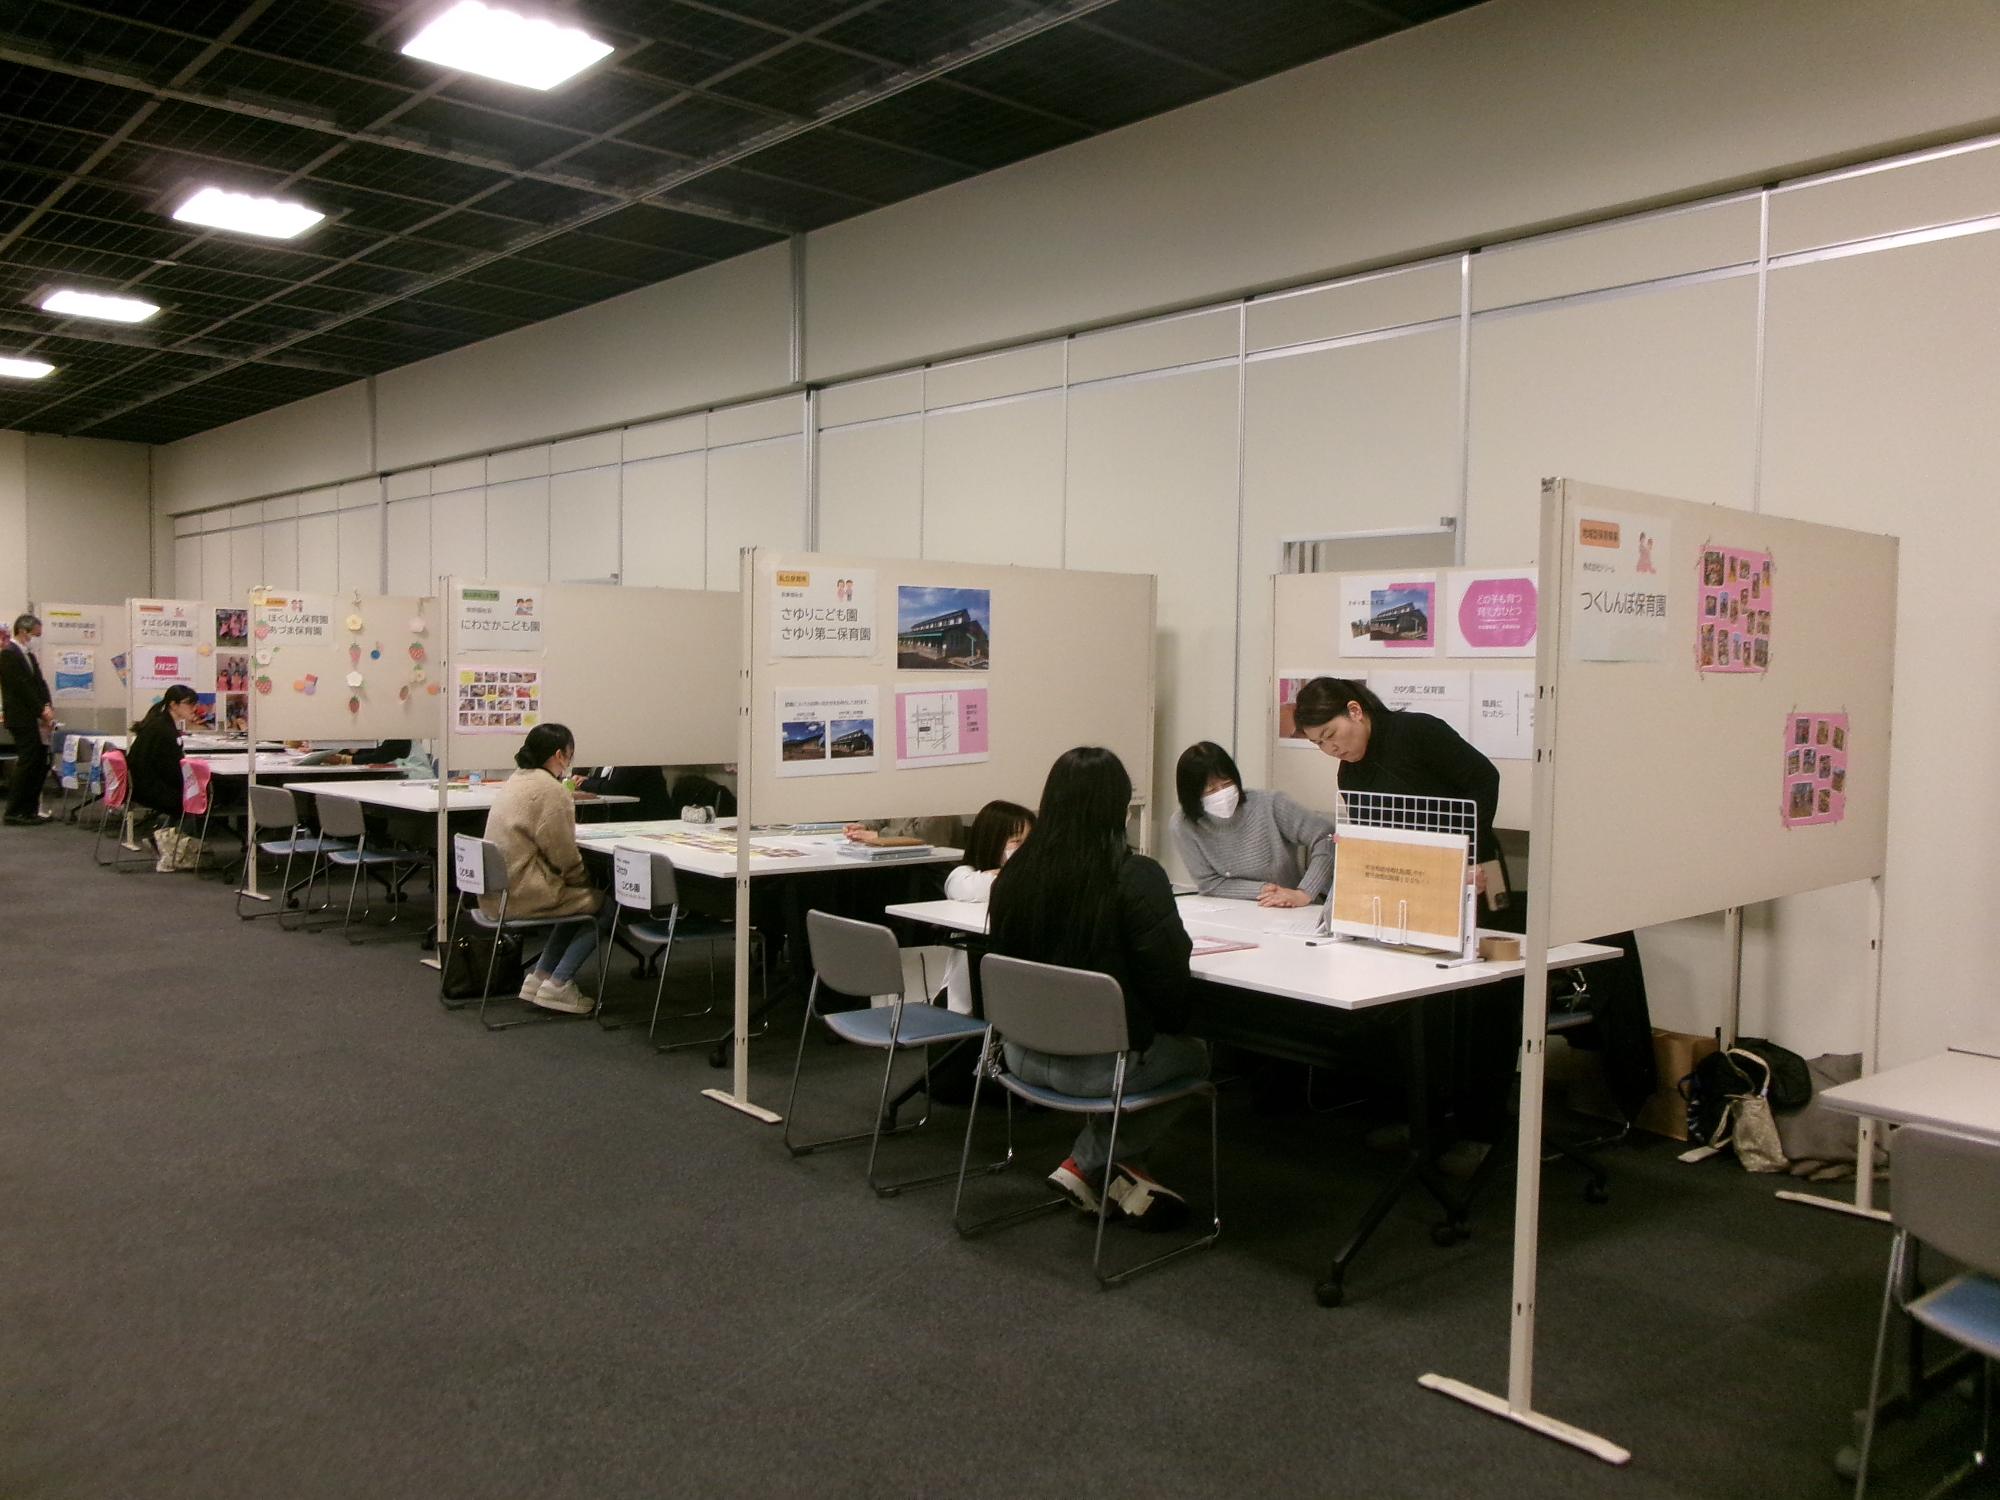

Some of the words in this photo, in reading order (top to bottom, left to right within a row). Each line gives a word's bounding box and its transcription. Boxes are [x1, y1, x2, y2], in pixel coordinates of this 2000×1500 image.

[1581, 590, 1666, 617] つくしんぼ保育園
[781, 607, 858, 622] さゆりこども園
[461, 619, 540, 632] にわさかこども園
[781, 626, 871, 642] さゆり第二保育園
